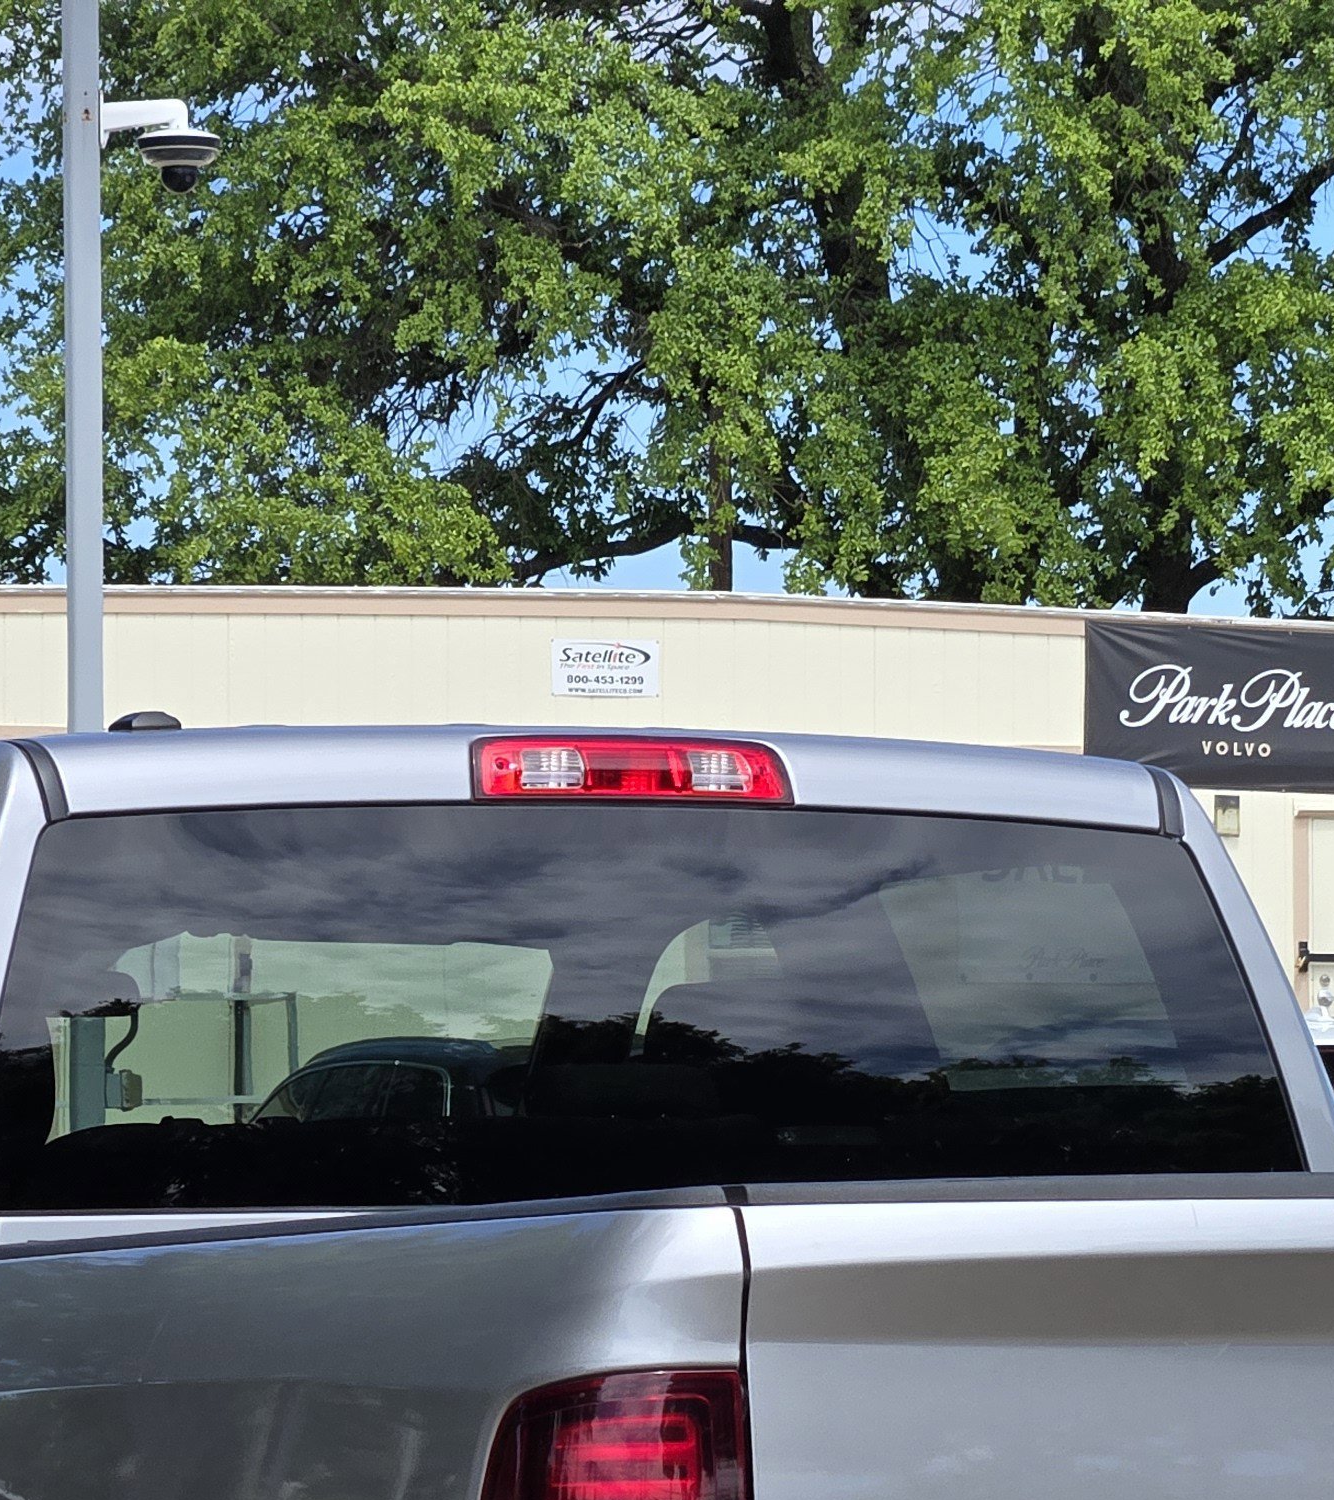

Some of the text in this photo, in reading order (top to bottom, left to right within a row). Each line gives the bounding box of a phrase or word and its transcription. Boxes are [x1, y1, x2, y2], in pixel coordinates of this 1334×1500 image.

[559, 647, 636, 663] Satellite
[567, 674, 644, 685] 800-453-1299
[1120, 663, 1236, 728] Park
[1201, 740, 1272, 758] VOLVO
